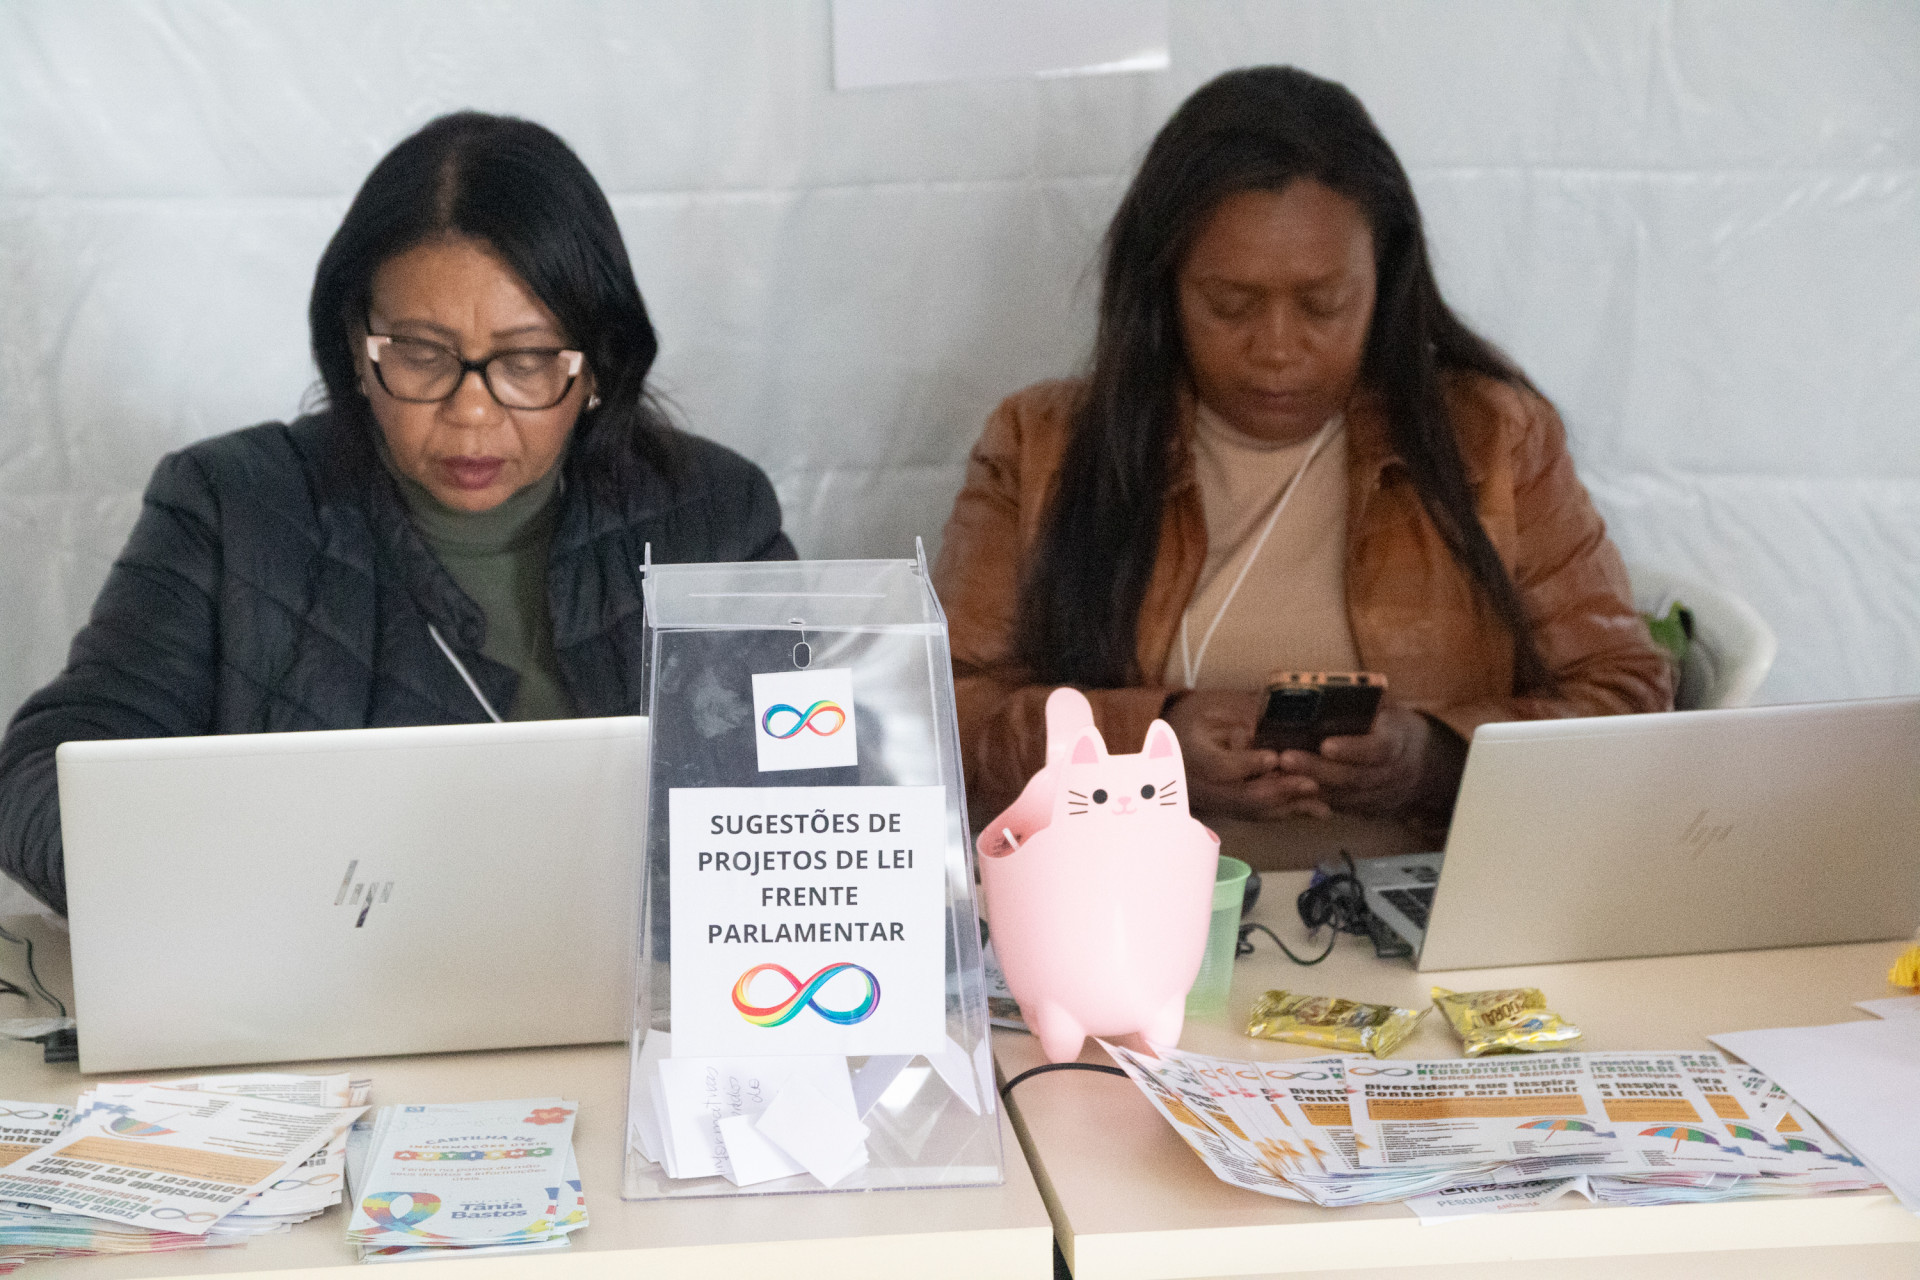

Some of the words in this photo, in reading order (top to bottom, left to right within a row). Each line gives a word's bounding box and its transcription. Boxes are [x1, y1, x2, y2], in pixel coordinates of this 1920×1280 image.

[710, 809, 860, 834] SUGESTÕES
[869, 813, 901, 833] DE
[699, 850, 828, 875] PROJETOS
[836, 850, 868, 869] DE
[878, 849, 914, 869] LEI
[762, 886, 858, 906] FRENTE
[708, 922, 906, 943] PARLAMENTAR
[1417, 1062, 1582, 1075] NEURODIVERSIDADE
[425, 1135, 508, 1145] CARTILHA
[397, 1148, 547, 1159] AUTISMO
[460, 1201, 523, 1211] Tânia
[1437, 1195, 1503, 1207] PESQUISA
[451, 1210, 527, 1219] Bastos
